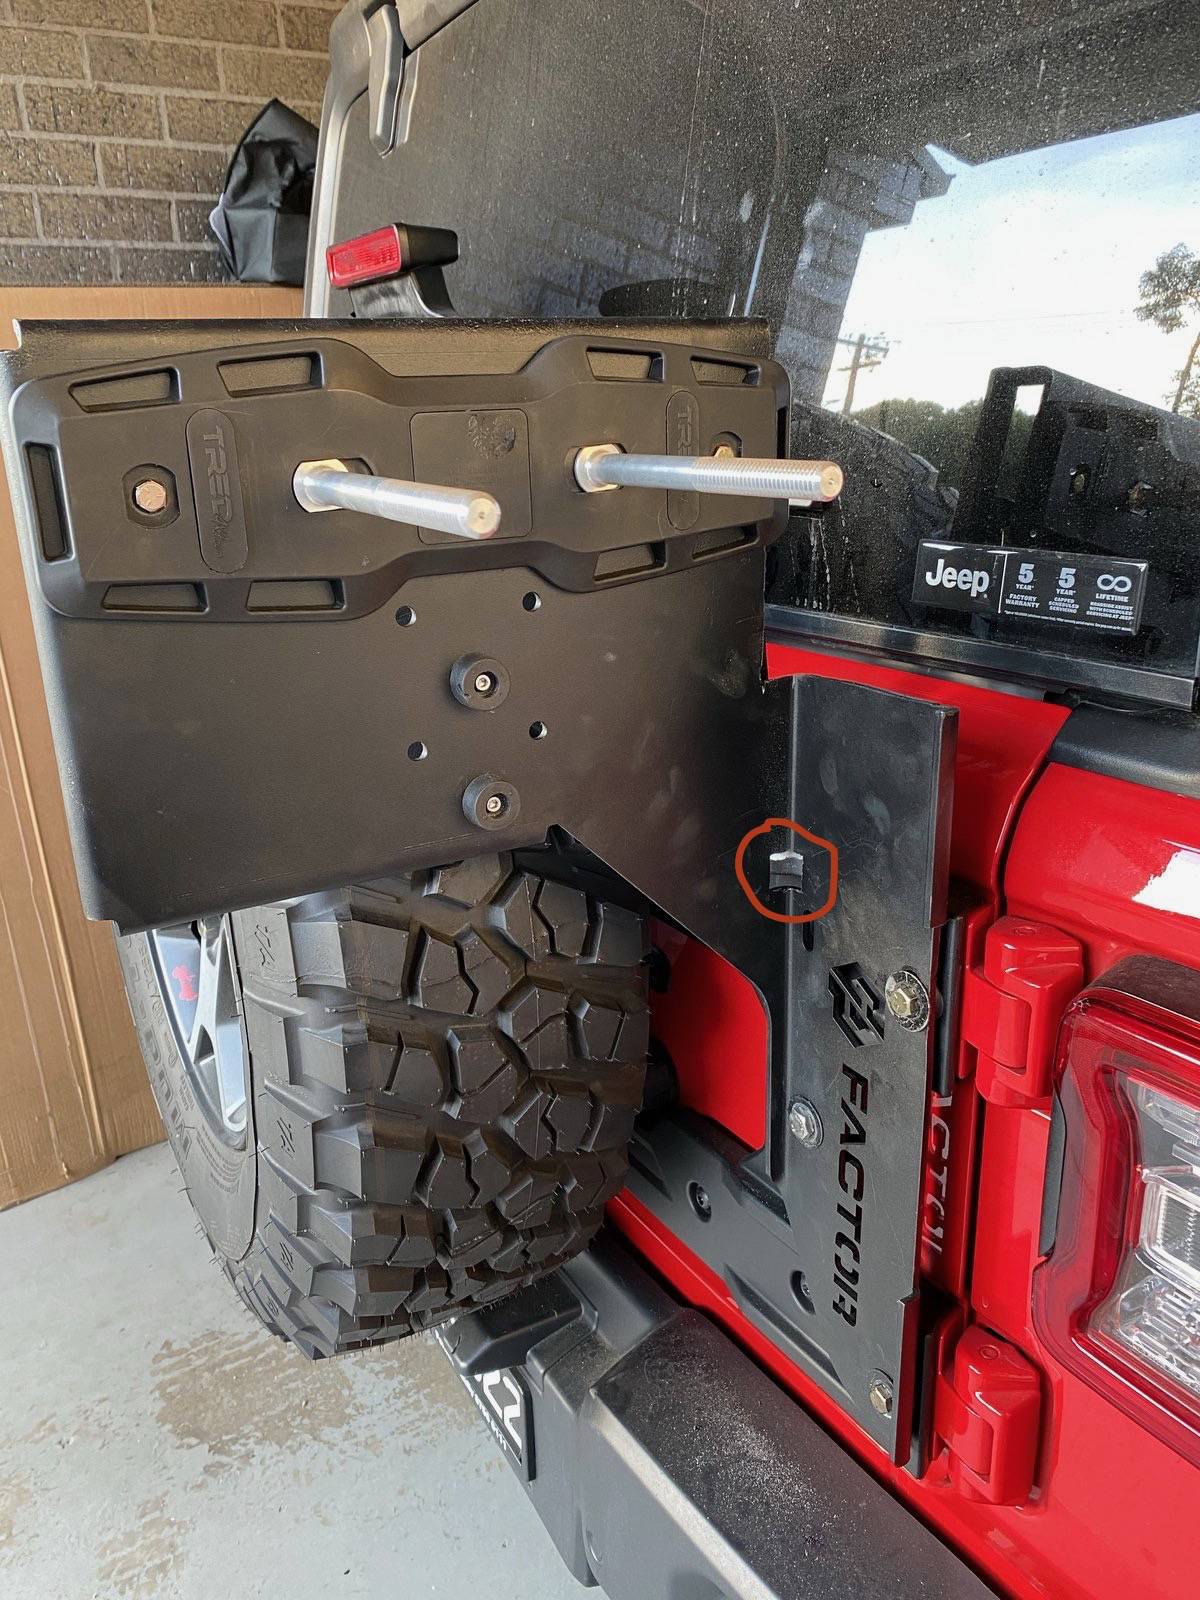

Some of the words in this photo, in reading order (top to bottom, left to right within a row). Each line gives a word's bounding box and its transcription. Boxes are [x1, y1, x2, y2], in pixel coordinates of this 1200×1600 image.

[203, 425, 233, 521] TRED
[926, 558, 990, 598] Jeep
[1018, 563, 1035, 583] 5
[1058, 567, 1076, 588] 5
[1005, 599, 1040, 608] WARRANTY
[1009, 593, 1037, 601] FACTORY
[1095, 593, 1129, 602] LIFETIME
[833, 1063, 868, 1327] FACTOR
